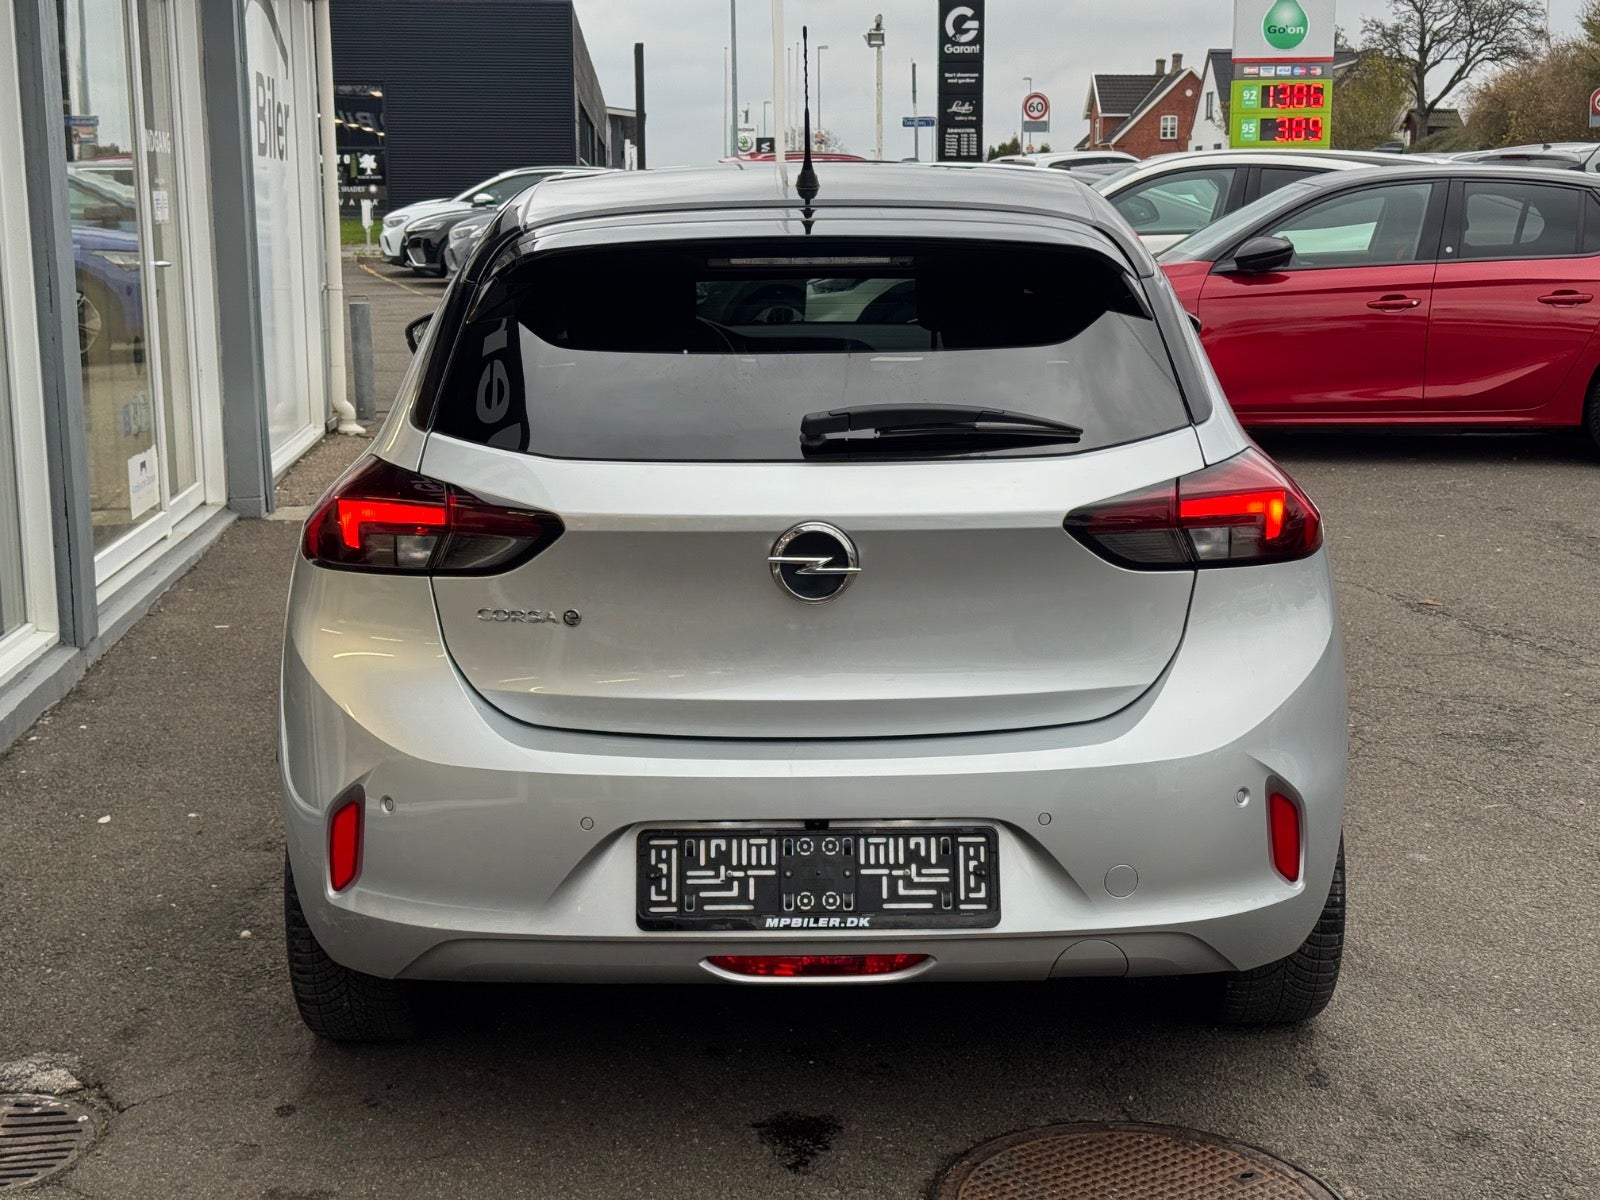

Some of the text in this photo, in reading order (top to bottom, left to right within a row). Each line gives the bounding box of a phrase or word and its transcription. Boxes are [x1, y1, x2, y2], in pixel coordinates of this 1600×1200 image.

[1268, 25, 1304, 35] Go'on
[944, 44, 980, 54] Garant
[1243, 90, 1257, 100] 92
[1028, 102, 1044, 113] 60
[256, 71, 290, 161] Biler
[1241, 123, 1256, 133] 95
[477, 608, 559, 624] CORSA
[765, 917, 870, 928] MPBILER.DK
